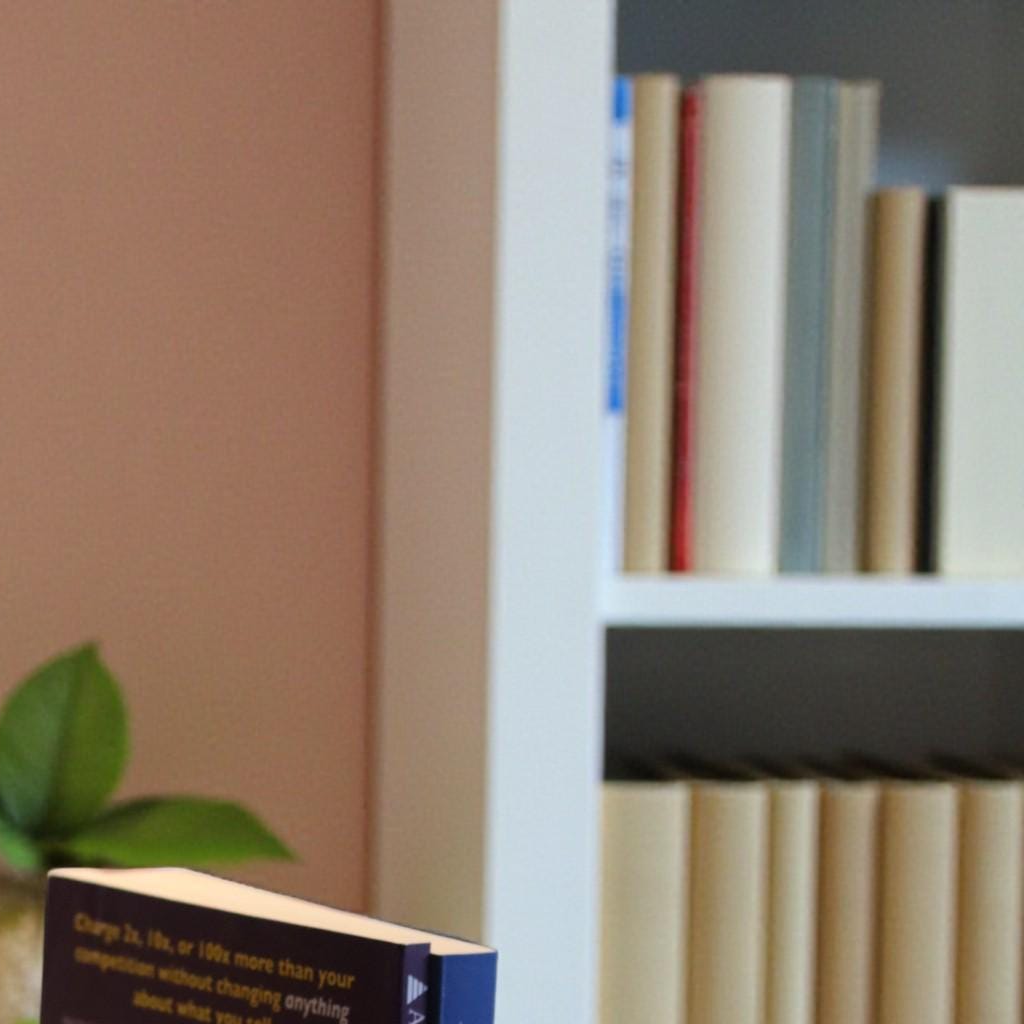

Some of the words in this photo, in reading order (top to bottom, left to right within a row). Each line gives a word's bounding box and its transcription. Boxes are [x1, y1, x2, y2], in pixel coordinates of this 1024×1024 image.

[73, 946, 155, 976] competition
[158, 967, 213, 993] without
[216, 977, 282, 1012] changing
[177, 939, 194, 957] or
[198, 940, 230, 965] 100x
[234, 951, 274, 974] more
[278, 957, 313, 982] than
[317, 969, 355, 991] your
[132, 988, 173, 1014] about
[177, 1000, 212, 1024] what
